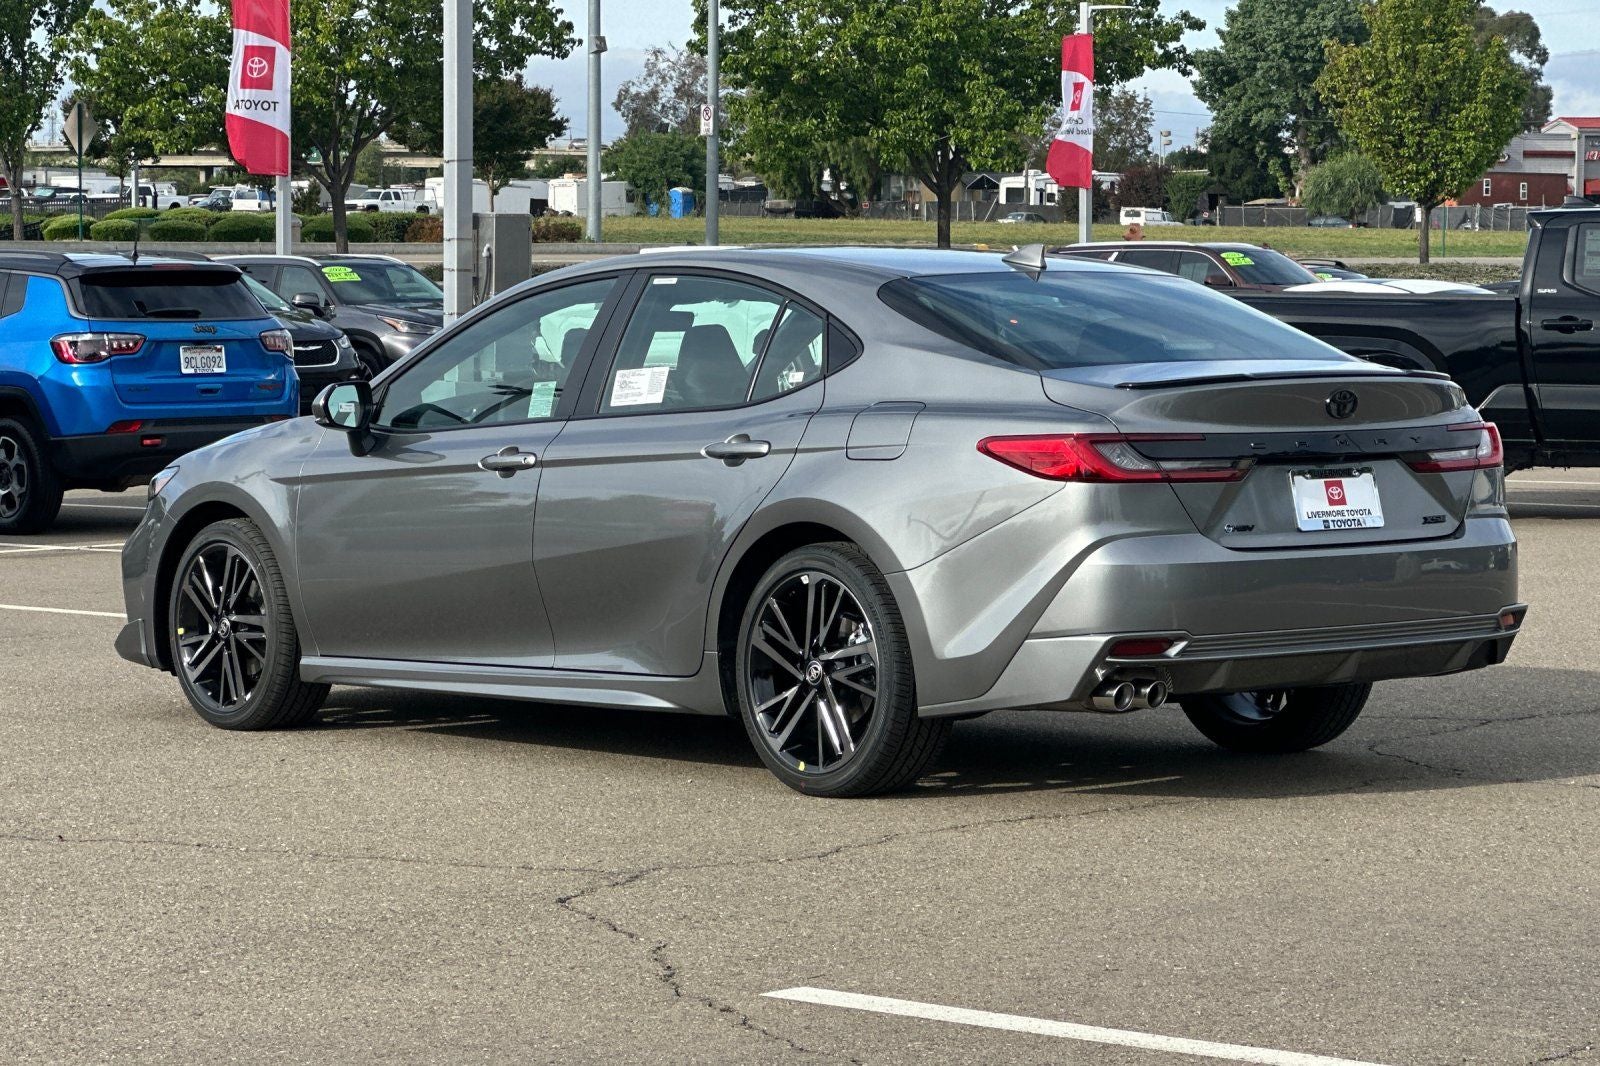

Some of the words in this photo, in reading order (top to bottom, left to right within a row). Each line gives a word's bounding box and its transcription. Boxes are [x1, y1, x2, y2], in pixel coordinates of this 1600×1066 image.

[184, 356, 223, 369] 9CLG092
[1250, 437, 1421, 449] CAMRY
[1306, 510, 1346, 519] LIVERMORE
[1346, 508, 1372, 517] TOYOTA
[1330, 518, 1363, 528] TOYOTA
